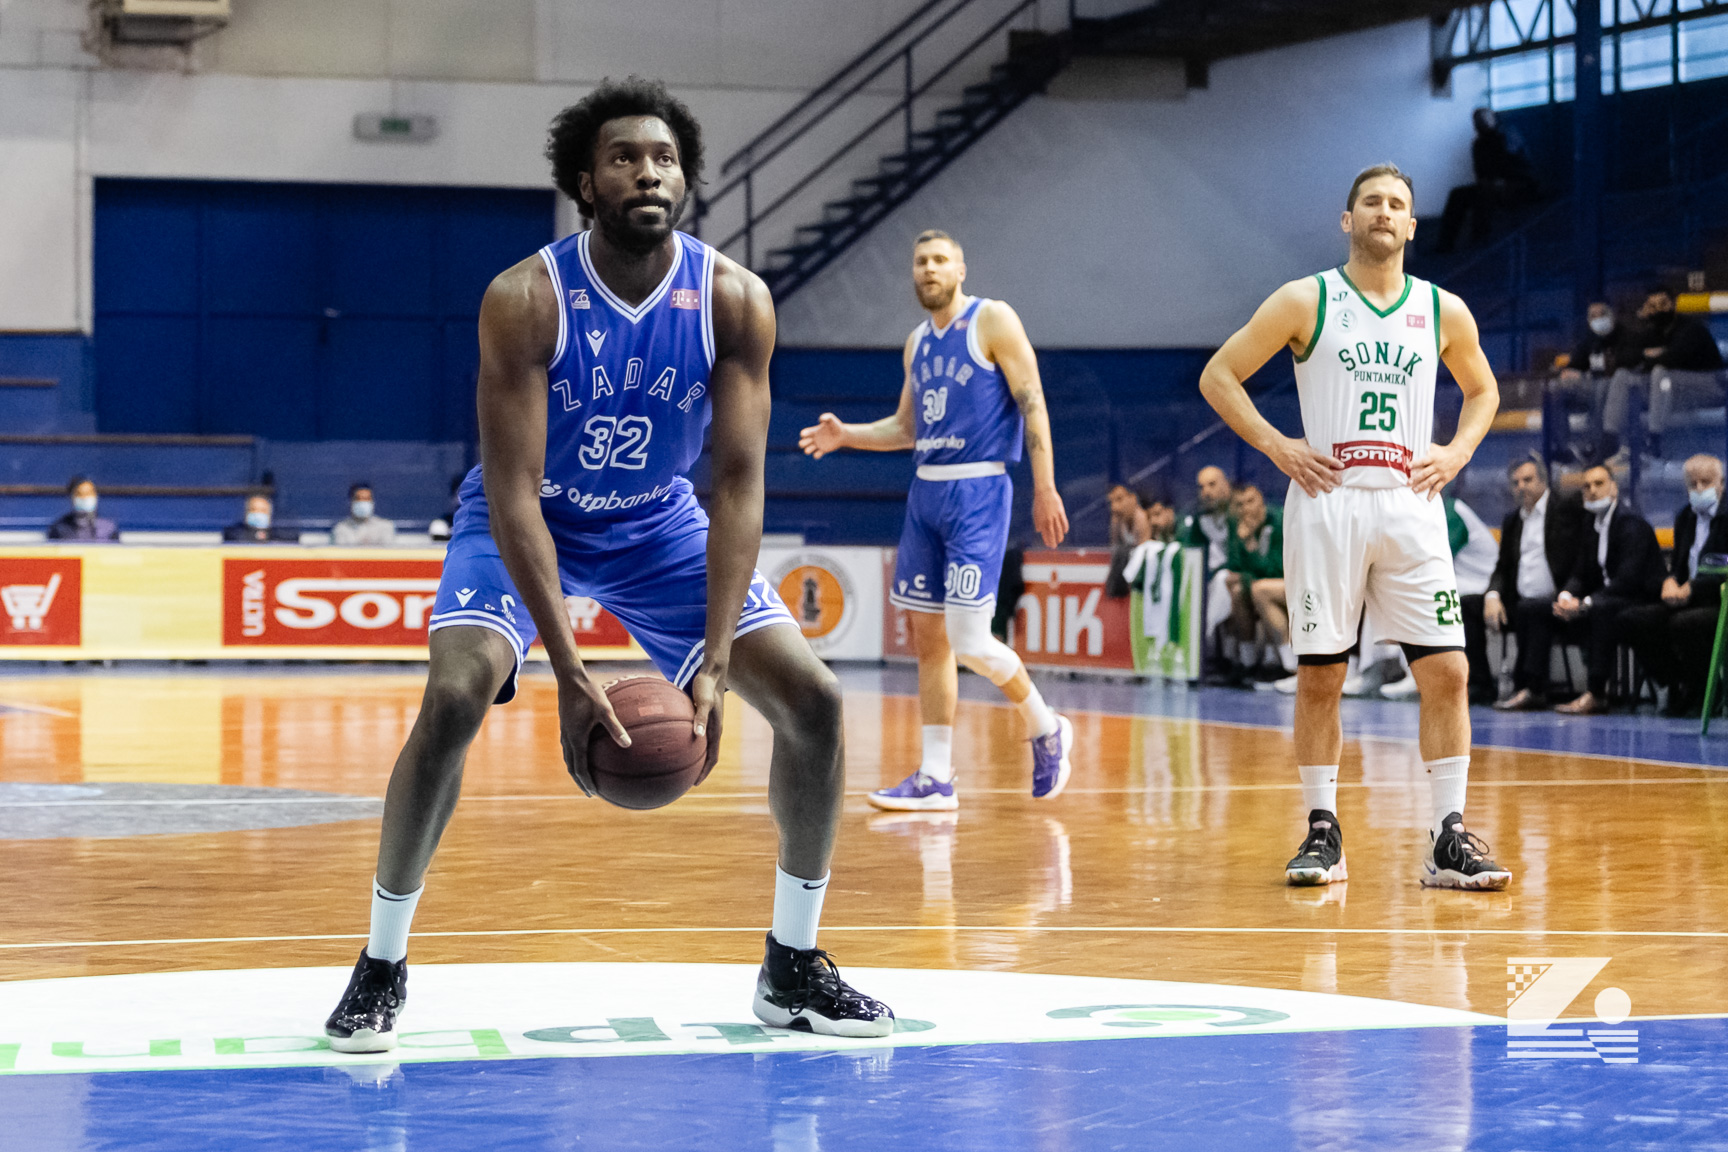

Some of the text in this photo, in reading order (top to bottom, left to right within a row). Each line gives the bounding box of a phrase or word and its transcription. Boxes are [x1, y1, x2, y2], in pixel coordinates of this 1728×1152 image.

[1338, 341, 1423, 377] SONIK
[1354, 370, 1407, 386] PUNTAMIKA
[552, 357, 706, 413] ZADAR
[1358, 391, 1399, 432] 25
[578, 415, 653, 470] 32
